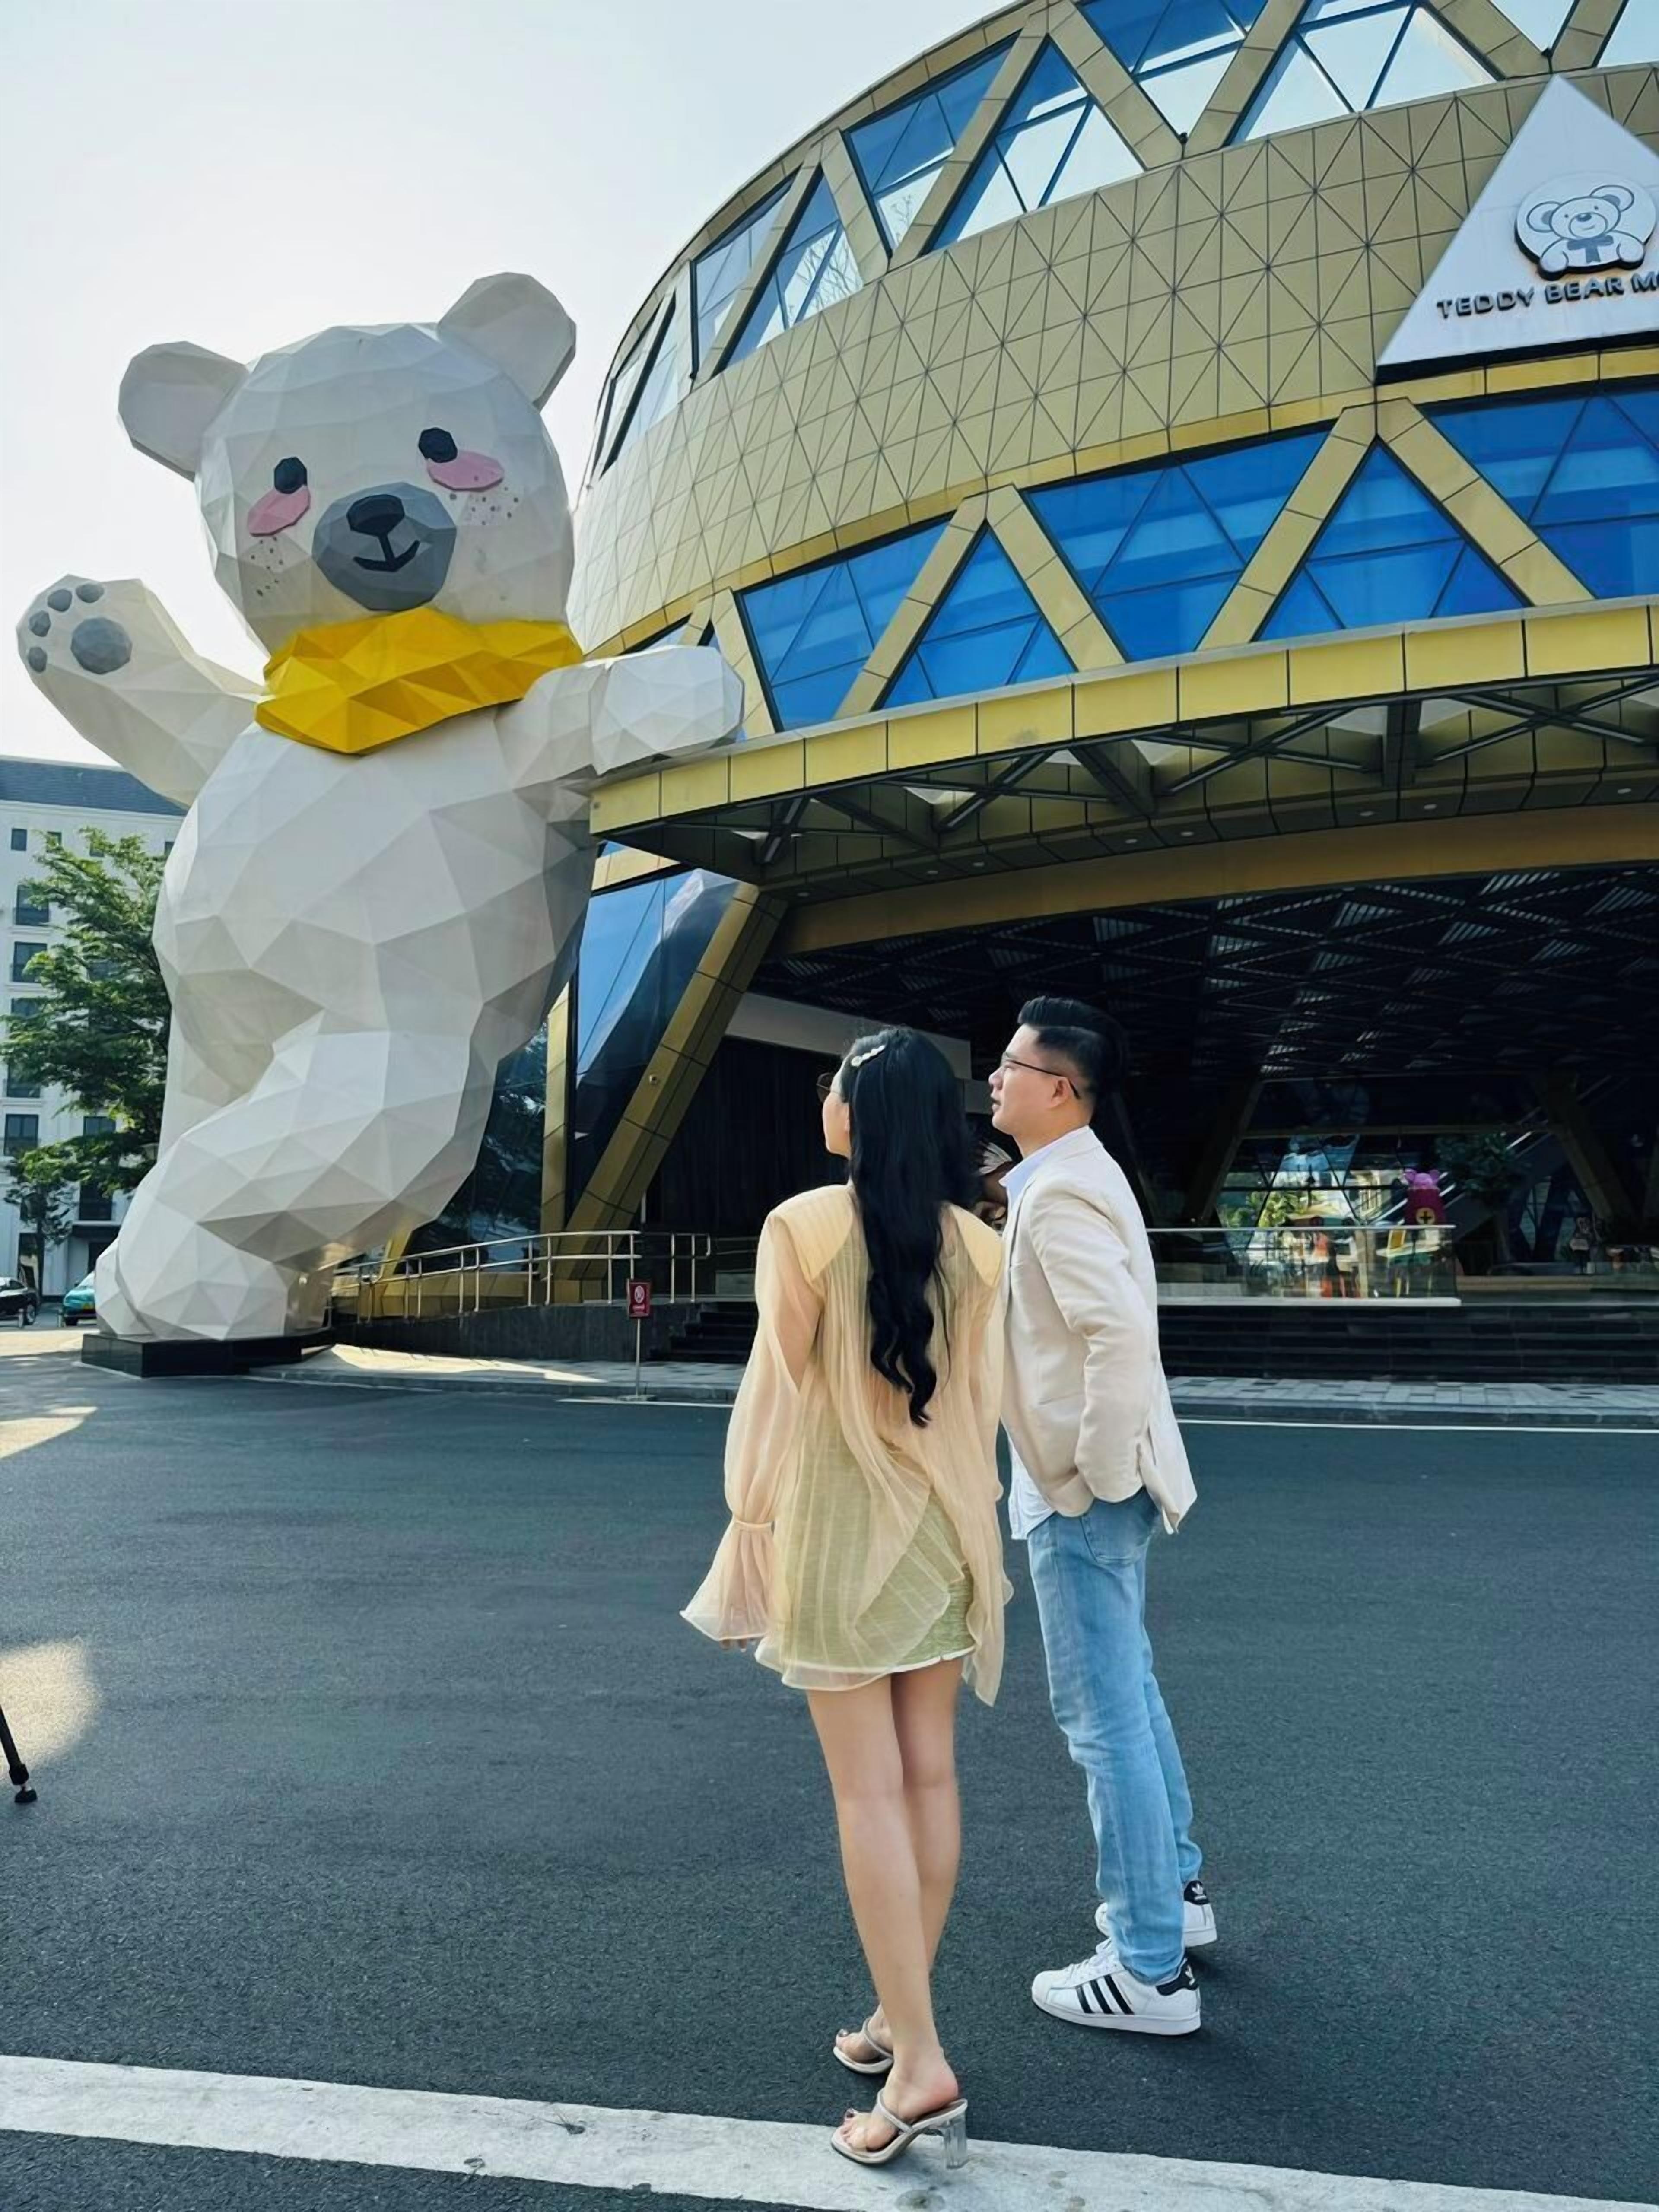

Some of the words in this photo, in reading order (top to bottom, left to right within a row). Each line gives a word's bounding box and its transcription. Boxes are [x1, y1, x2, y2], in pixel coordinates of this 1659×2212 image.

[1437, 286, 1534, 319] TEDDY
[1545, 276, 1624, 304] BEAR
[1630, 270, 1659, 293] M
